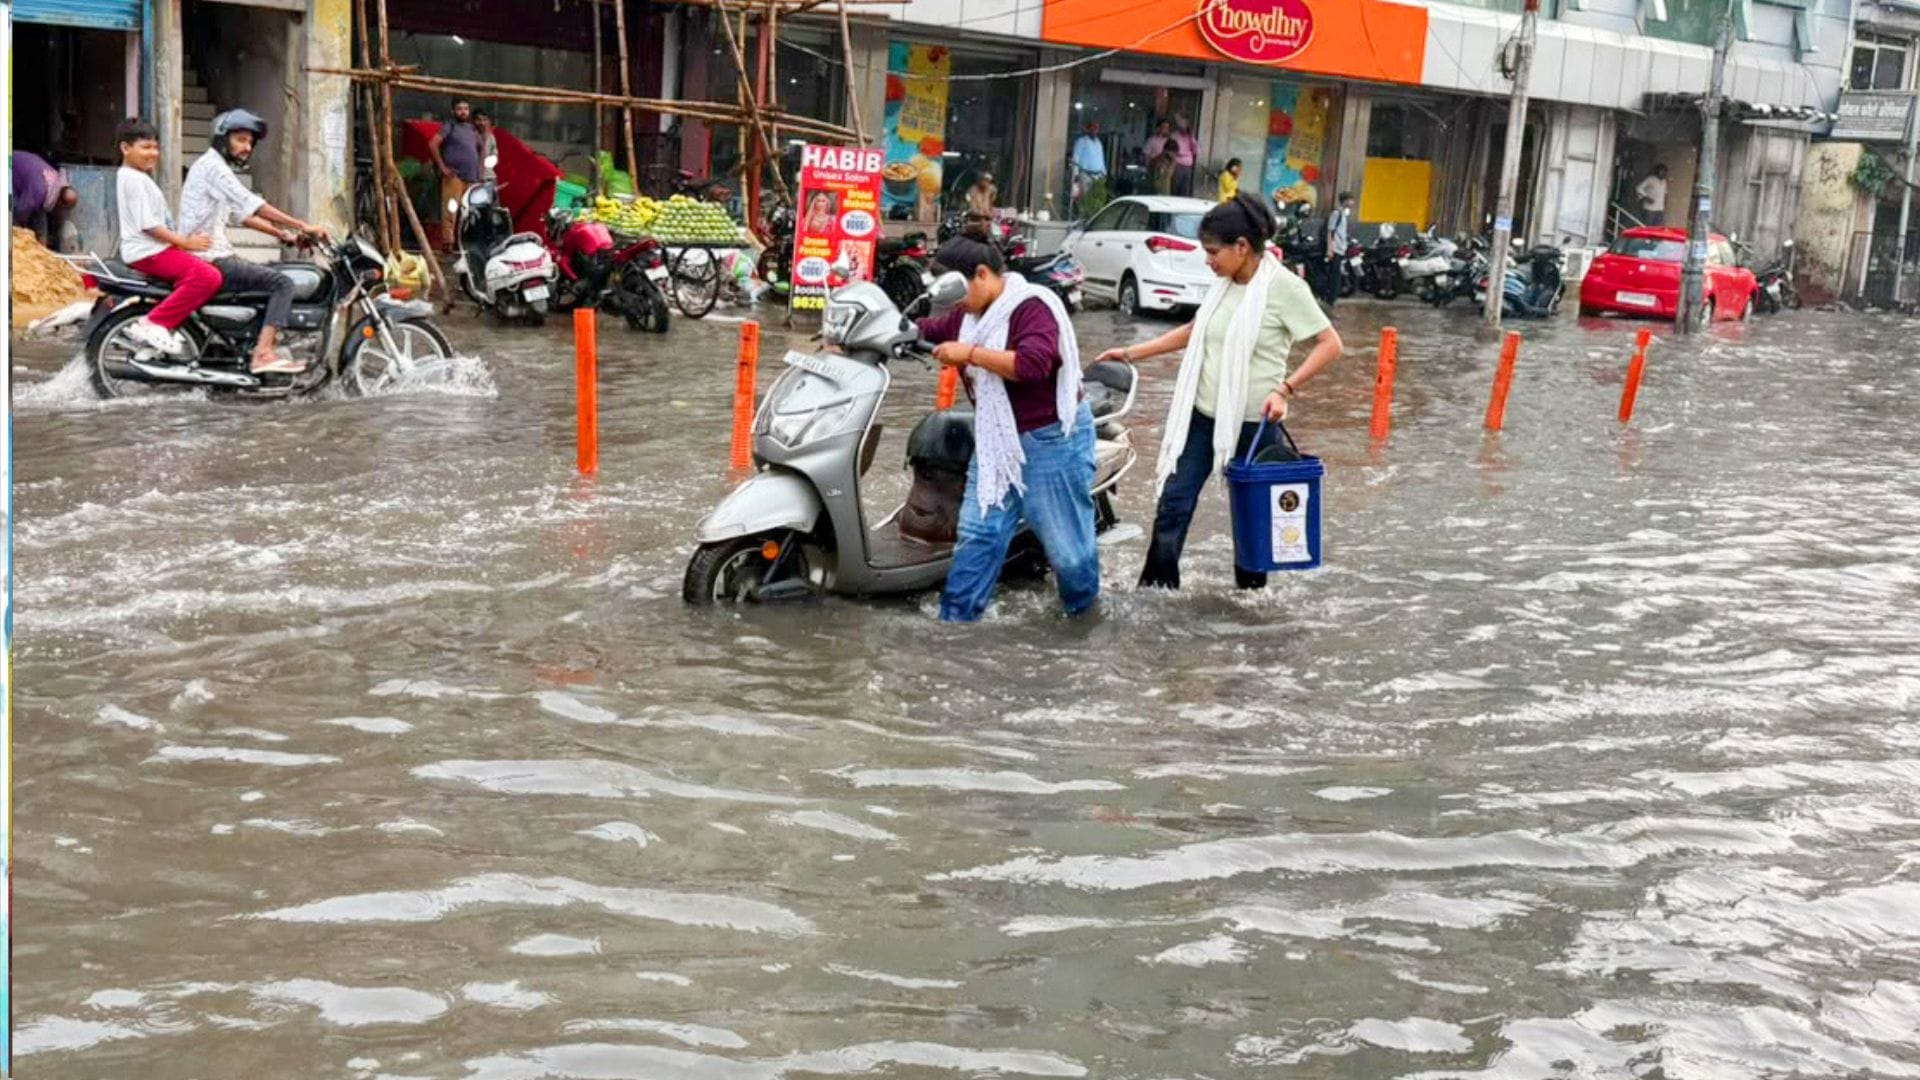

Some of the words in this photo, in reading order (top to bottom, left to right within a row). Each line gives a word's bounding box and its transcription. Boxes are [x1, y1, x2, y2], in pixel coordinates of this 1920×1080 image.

[1206, 1, 1308, 51] Chowdhry
[803, 146, 881, 173] HABIB
[813, 170, 842, 181] Unisex
